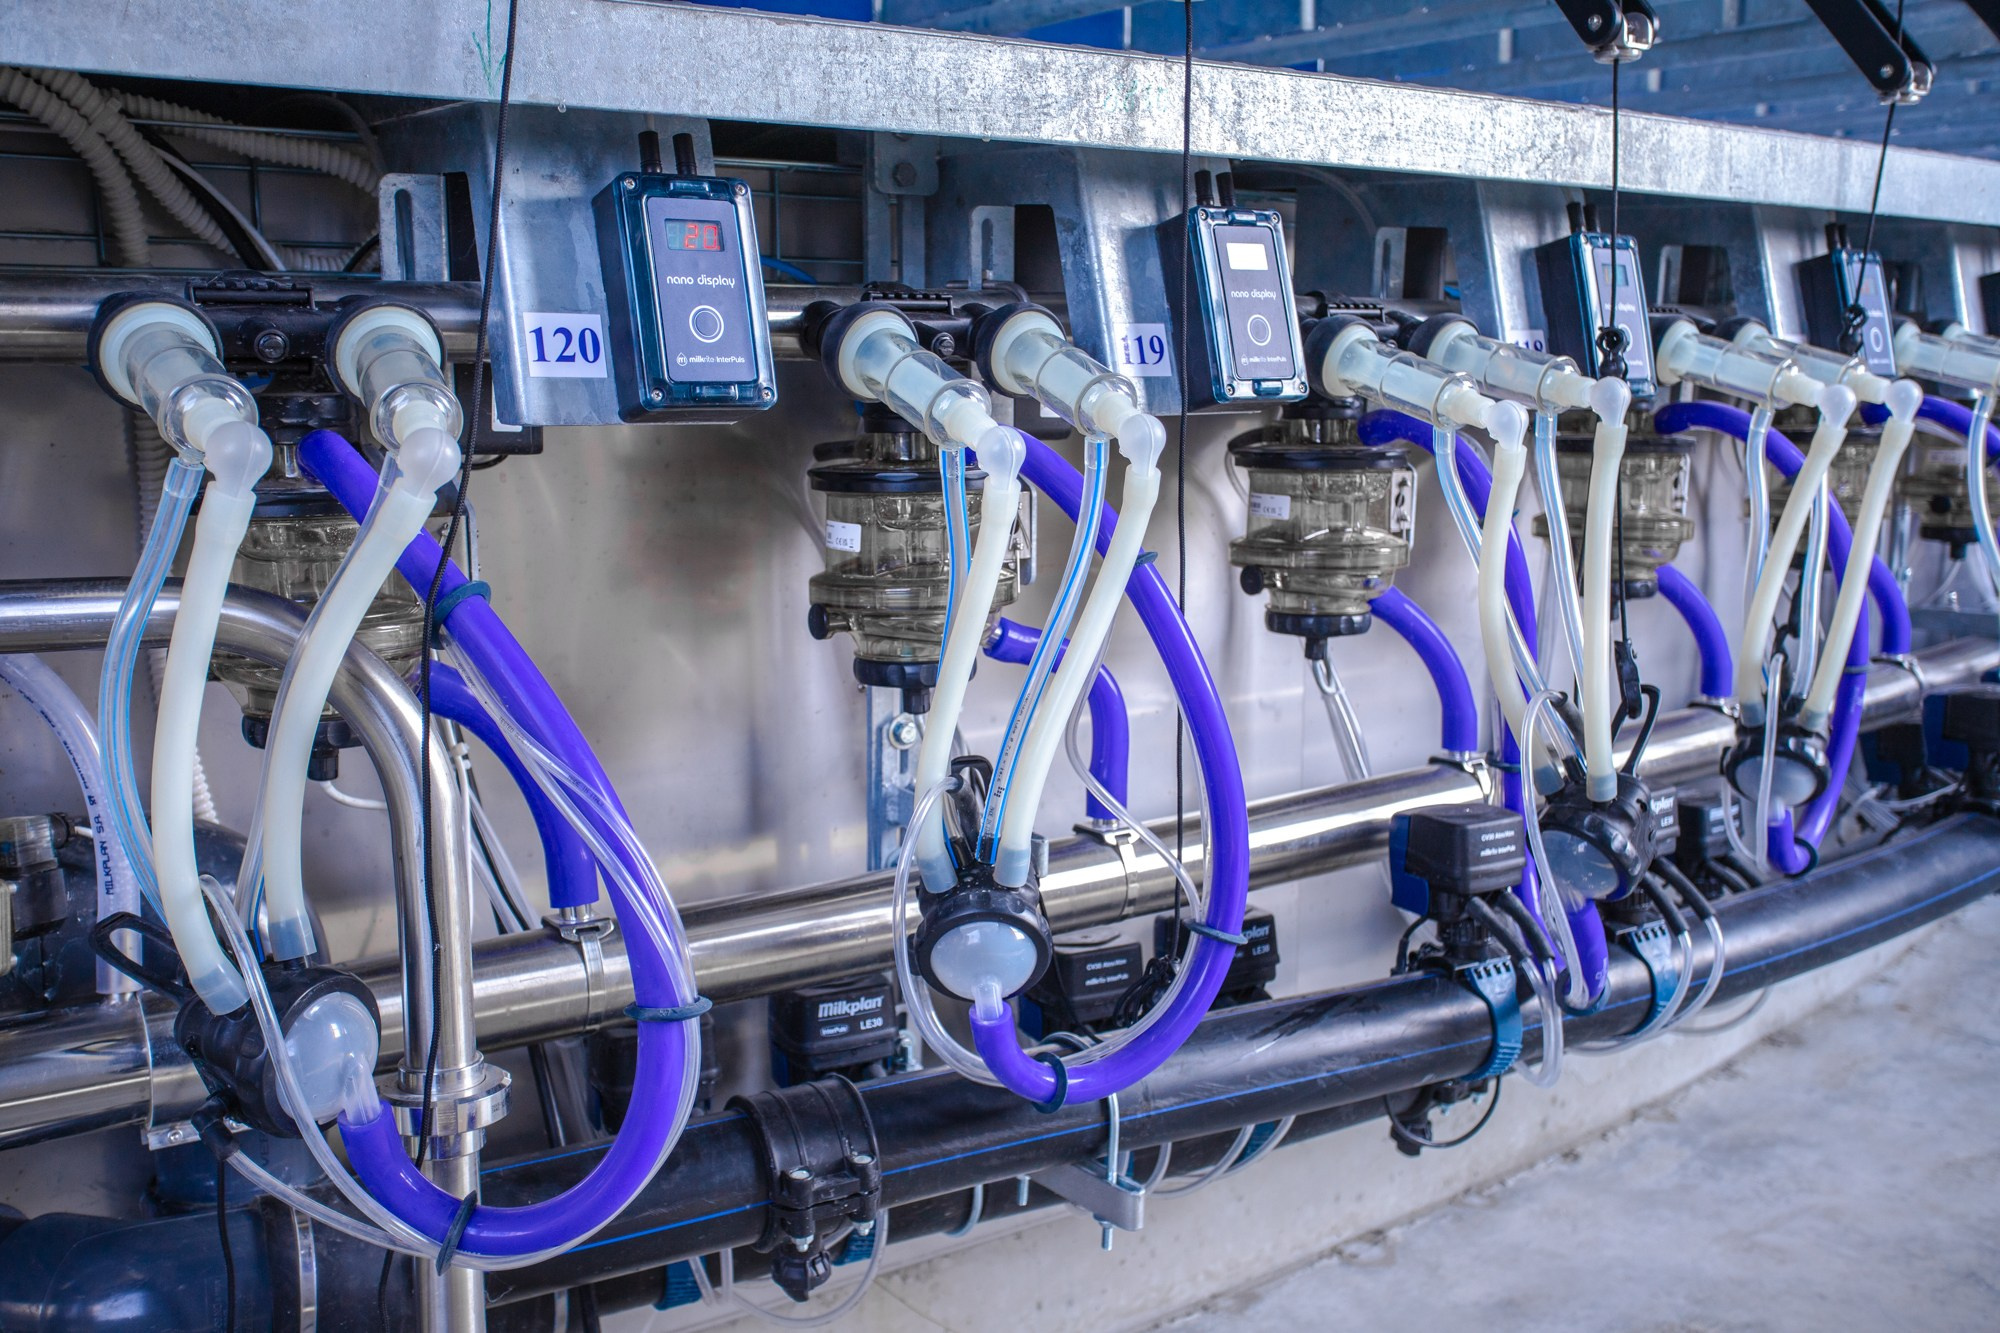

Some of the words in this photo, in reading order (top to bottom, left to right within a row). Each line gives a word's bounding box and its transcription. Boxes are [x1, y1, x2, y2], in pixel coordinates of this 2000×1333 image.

[667, 276, 694, 285] nano
[697, 274, 735, 288] display
[1231, 290, 1249, 299] nano
[1251, 289, 1277, 300] display
[528, 326, 600, 363] 120
[1120, 334, 1165, 365] 119
[716, 355, 745, 363] InterPuls
[99, 840, 114, 896] MILKPLAN
[818, 995, 885, 1018] Milkplan
[860, 1017, 884, 1030] LE30
